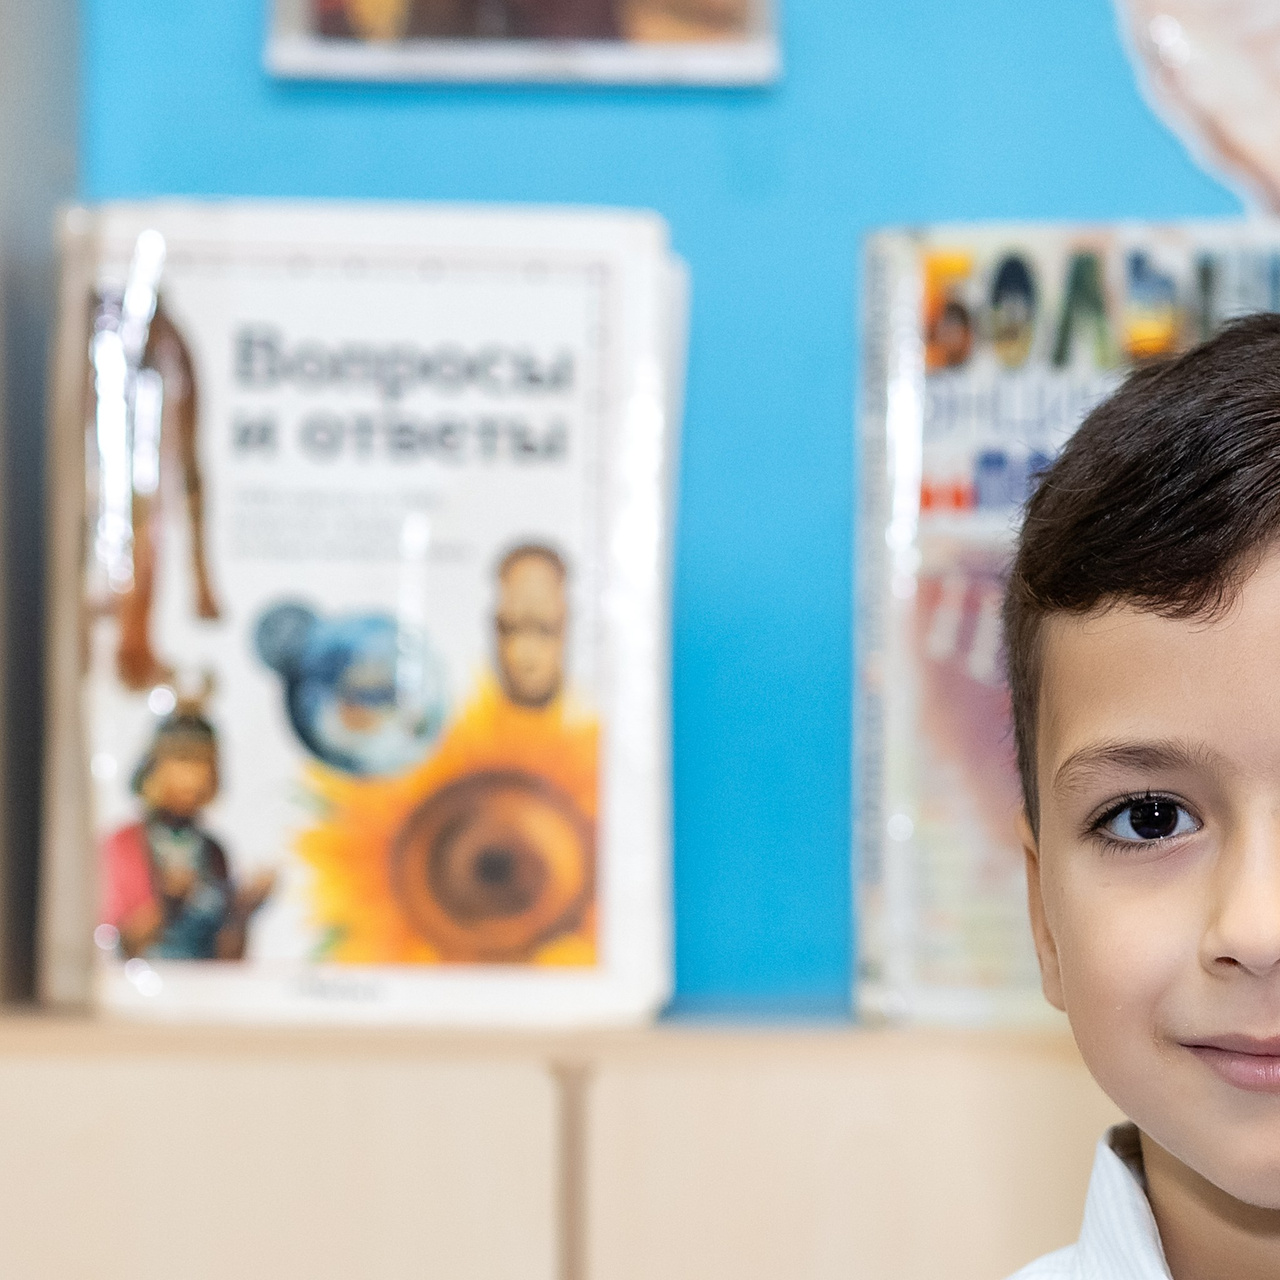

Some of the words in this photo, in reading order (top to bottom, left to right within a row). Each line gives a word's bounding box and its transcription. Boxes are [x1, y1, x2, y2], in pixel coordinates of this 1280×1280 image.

[232, 325, 575, 402] Вопросы
[230, 412, 278, 460] и
[299, 412, 569, 464] ответы
